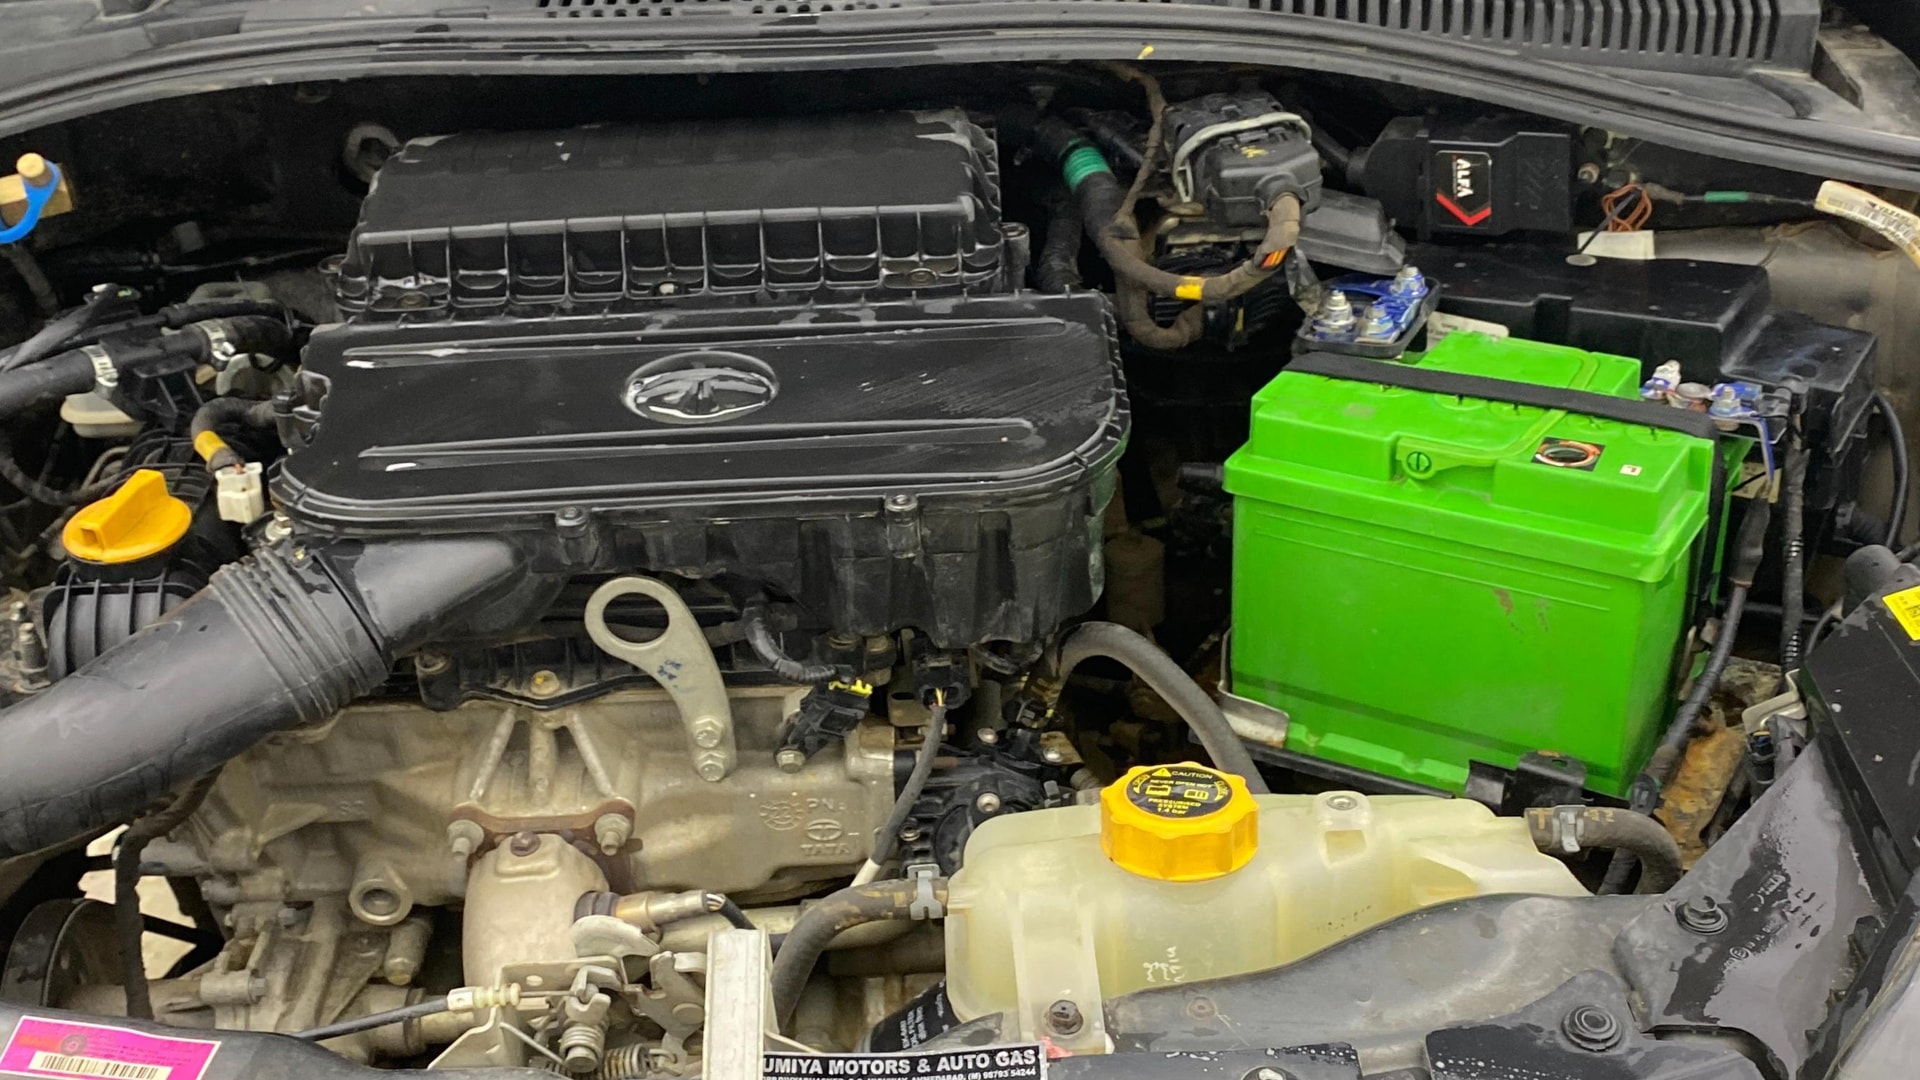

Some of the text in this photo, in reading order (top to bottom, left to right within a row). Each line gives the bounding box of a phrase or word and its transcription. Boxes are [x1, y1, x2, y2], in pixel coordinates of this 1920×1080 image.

[1456, 158, 1474, 198] ALFA
[1171, 770, 1213, 780] CAUTION
[1175, 780, 1196, 788] OPEN
[1157, 803, 1189, 811] SYSTEM
[799, 843, 851, 856] TATA
[828, 1060, 911, 1075] MOTORS
[916, 1059, 931, 1073] &
[936, 1053, 990, 1072] AUTO
[995, 1049, 1036, 1067] GAS
[968, 1071, 982, 1080] (M)
[1010, 1066, 1036, 1077] 54244
